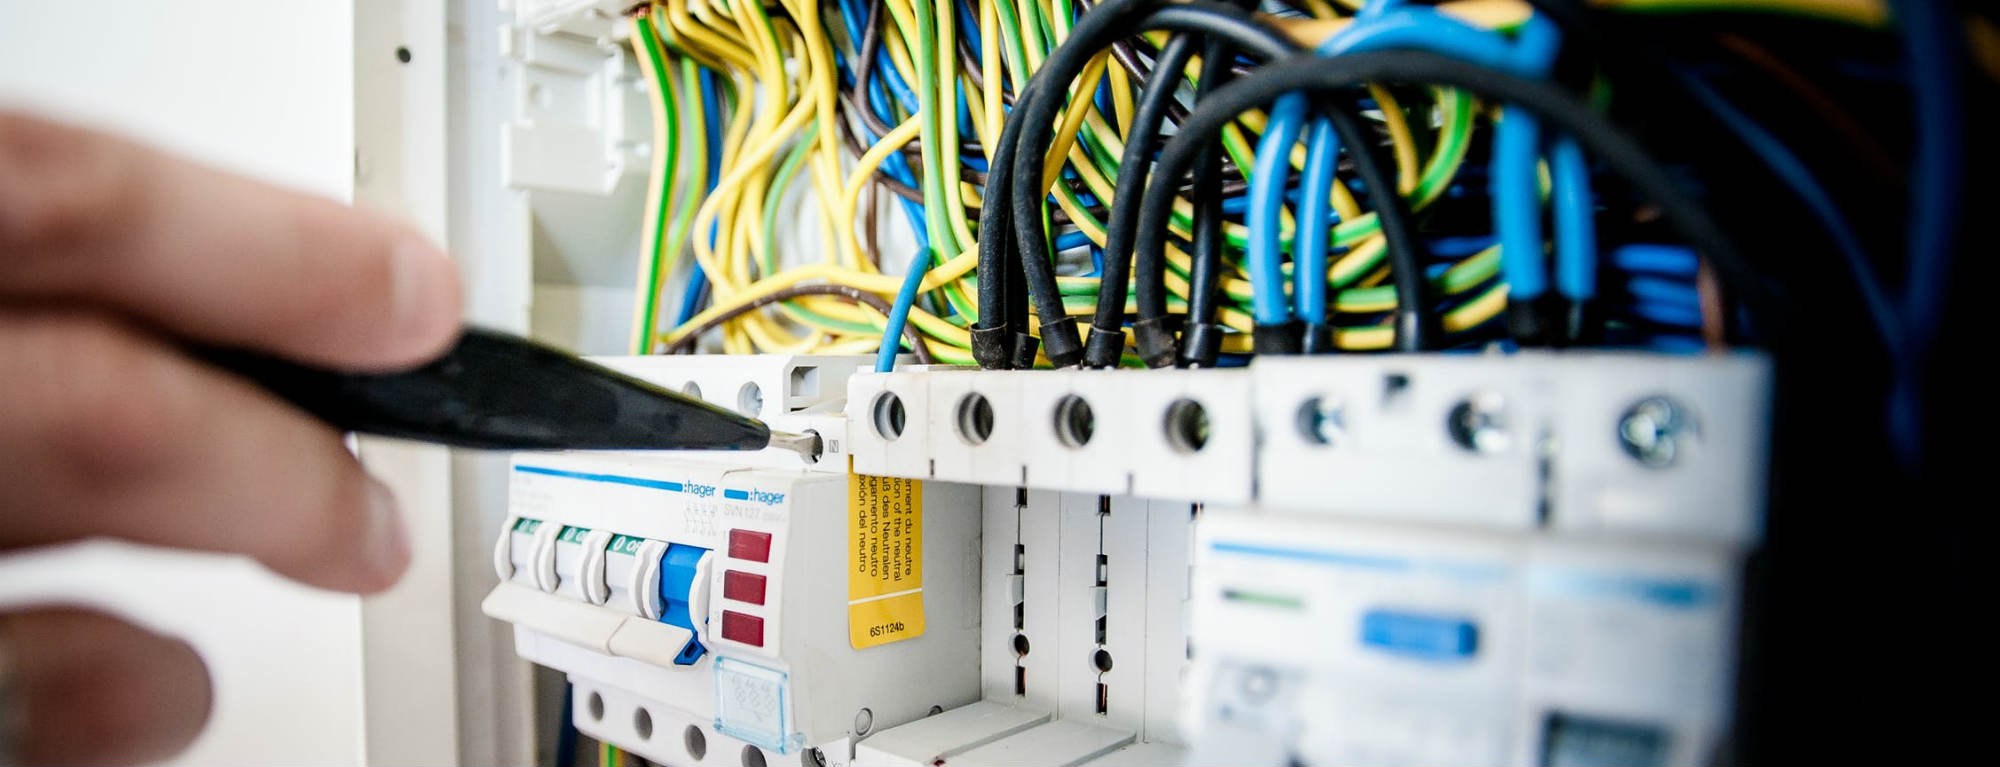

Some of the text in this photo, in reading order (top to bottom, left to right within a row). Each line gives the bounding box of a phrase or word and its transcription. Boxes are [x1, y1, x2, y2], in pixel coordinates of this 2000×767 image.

[858, 510, 868, 528] del
[882, 495, 891, 519] des
[893, 502, 902, 514] of
[893, 518, 903, 537] the
[904, 519, 913, 534] du
[858, 532, 867, 573] neutro
[870, 537, 879, 577] neutro
[882, 521, 891, 580] Neutralen
[893, 540, 903, 581] neutral
[904, 537, 913, 576] neutre
[870, 621, 905, 638] 6S1124b
